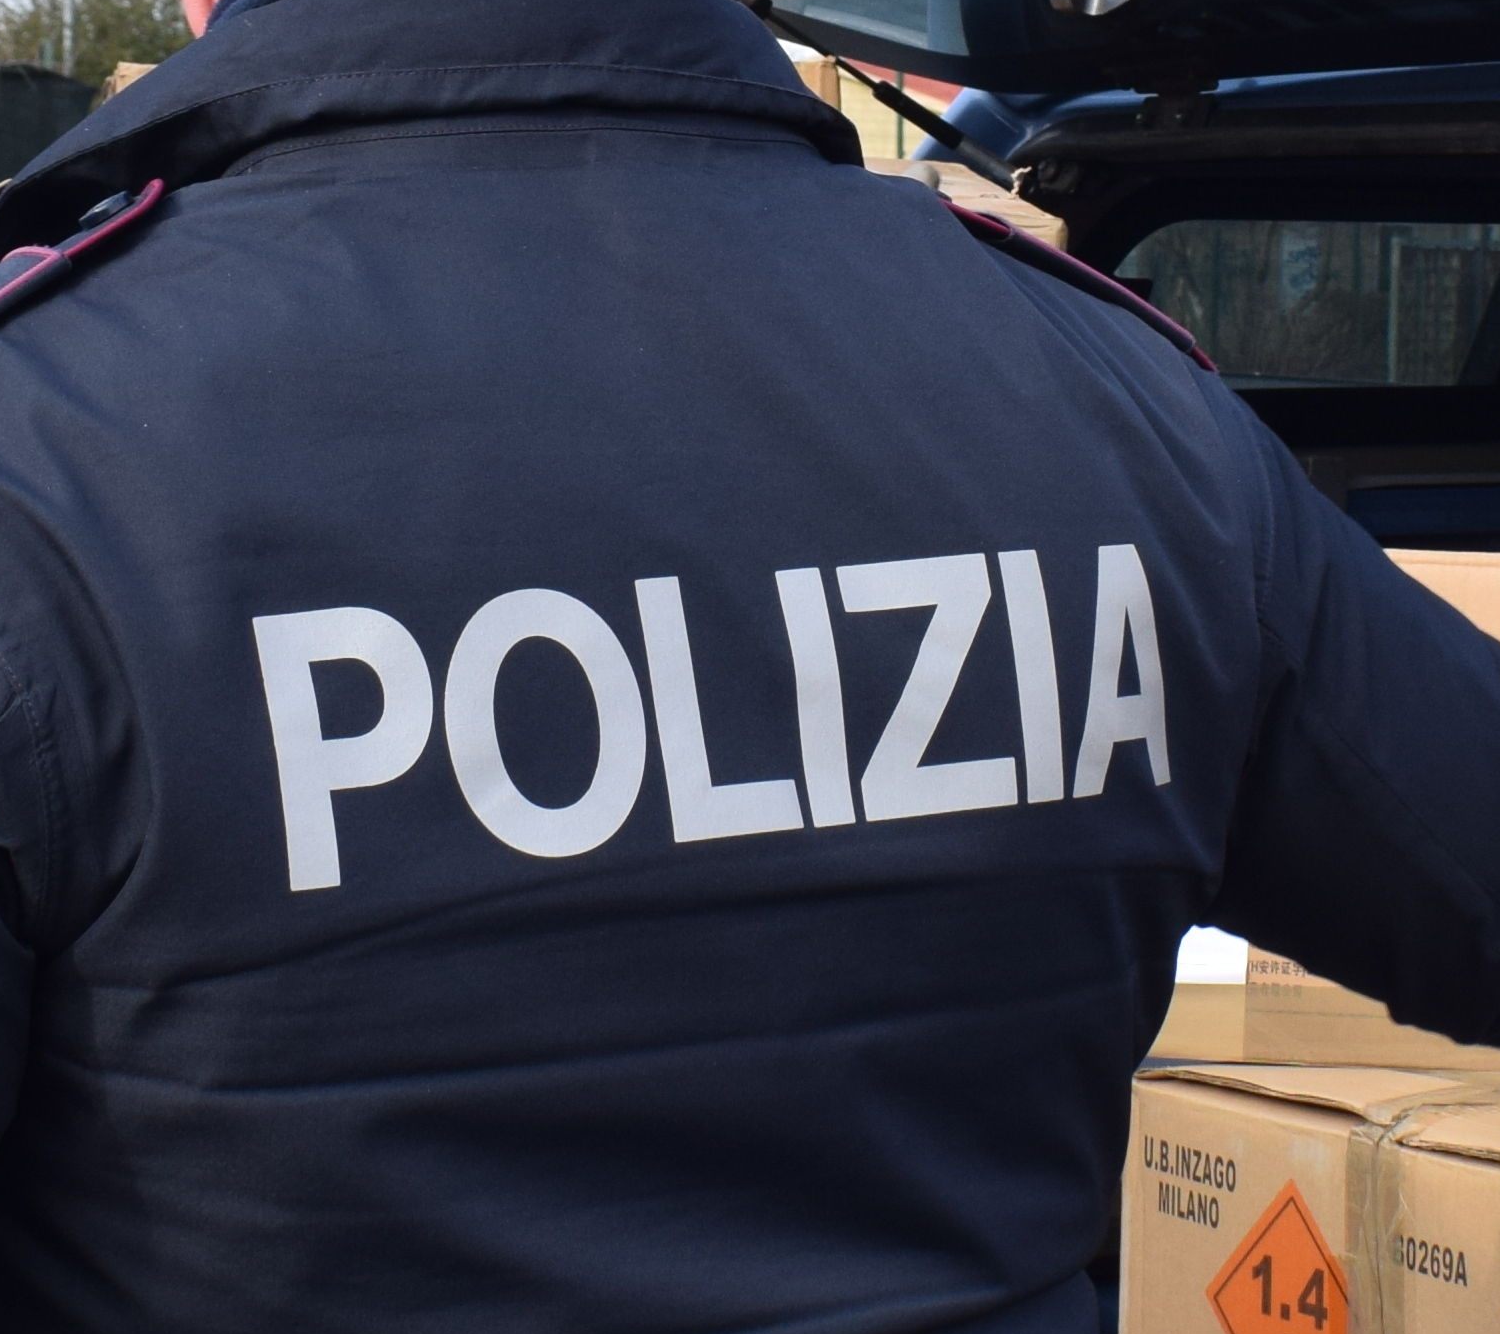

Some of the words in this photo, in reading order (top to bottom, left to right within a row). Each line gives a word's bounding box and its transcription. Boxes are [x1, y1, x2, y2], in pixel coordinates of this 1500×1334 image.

[252, 543, 1171, 891] POLIZIA
[1144, 1134, 1237, 1193] U.B.INZAGO
[1158, 1181, 1220, 1229] MILANO
[1252, 1254, 1328, 1331] 1.4
